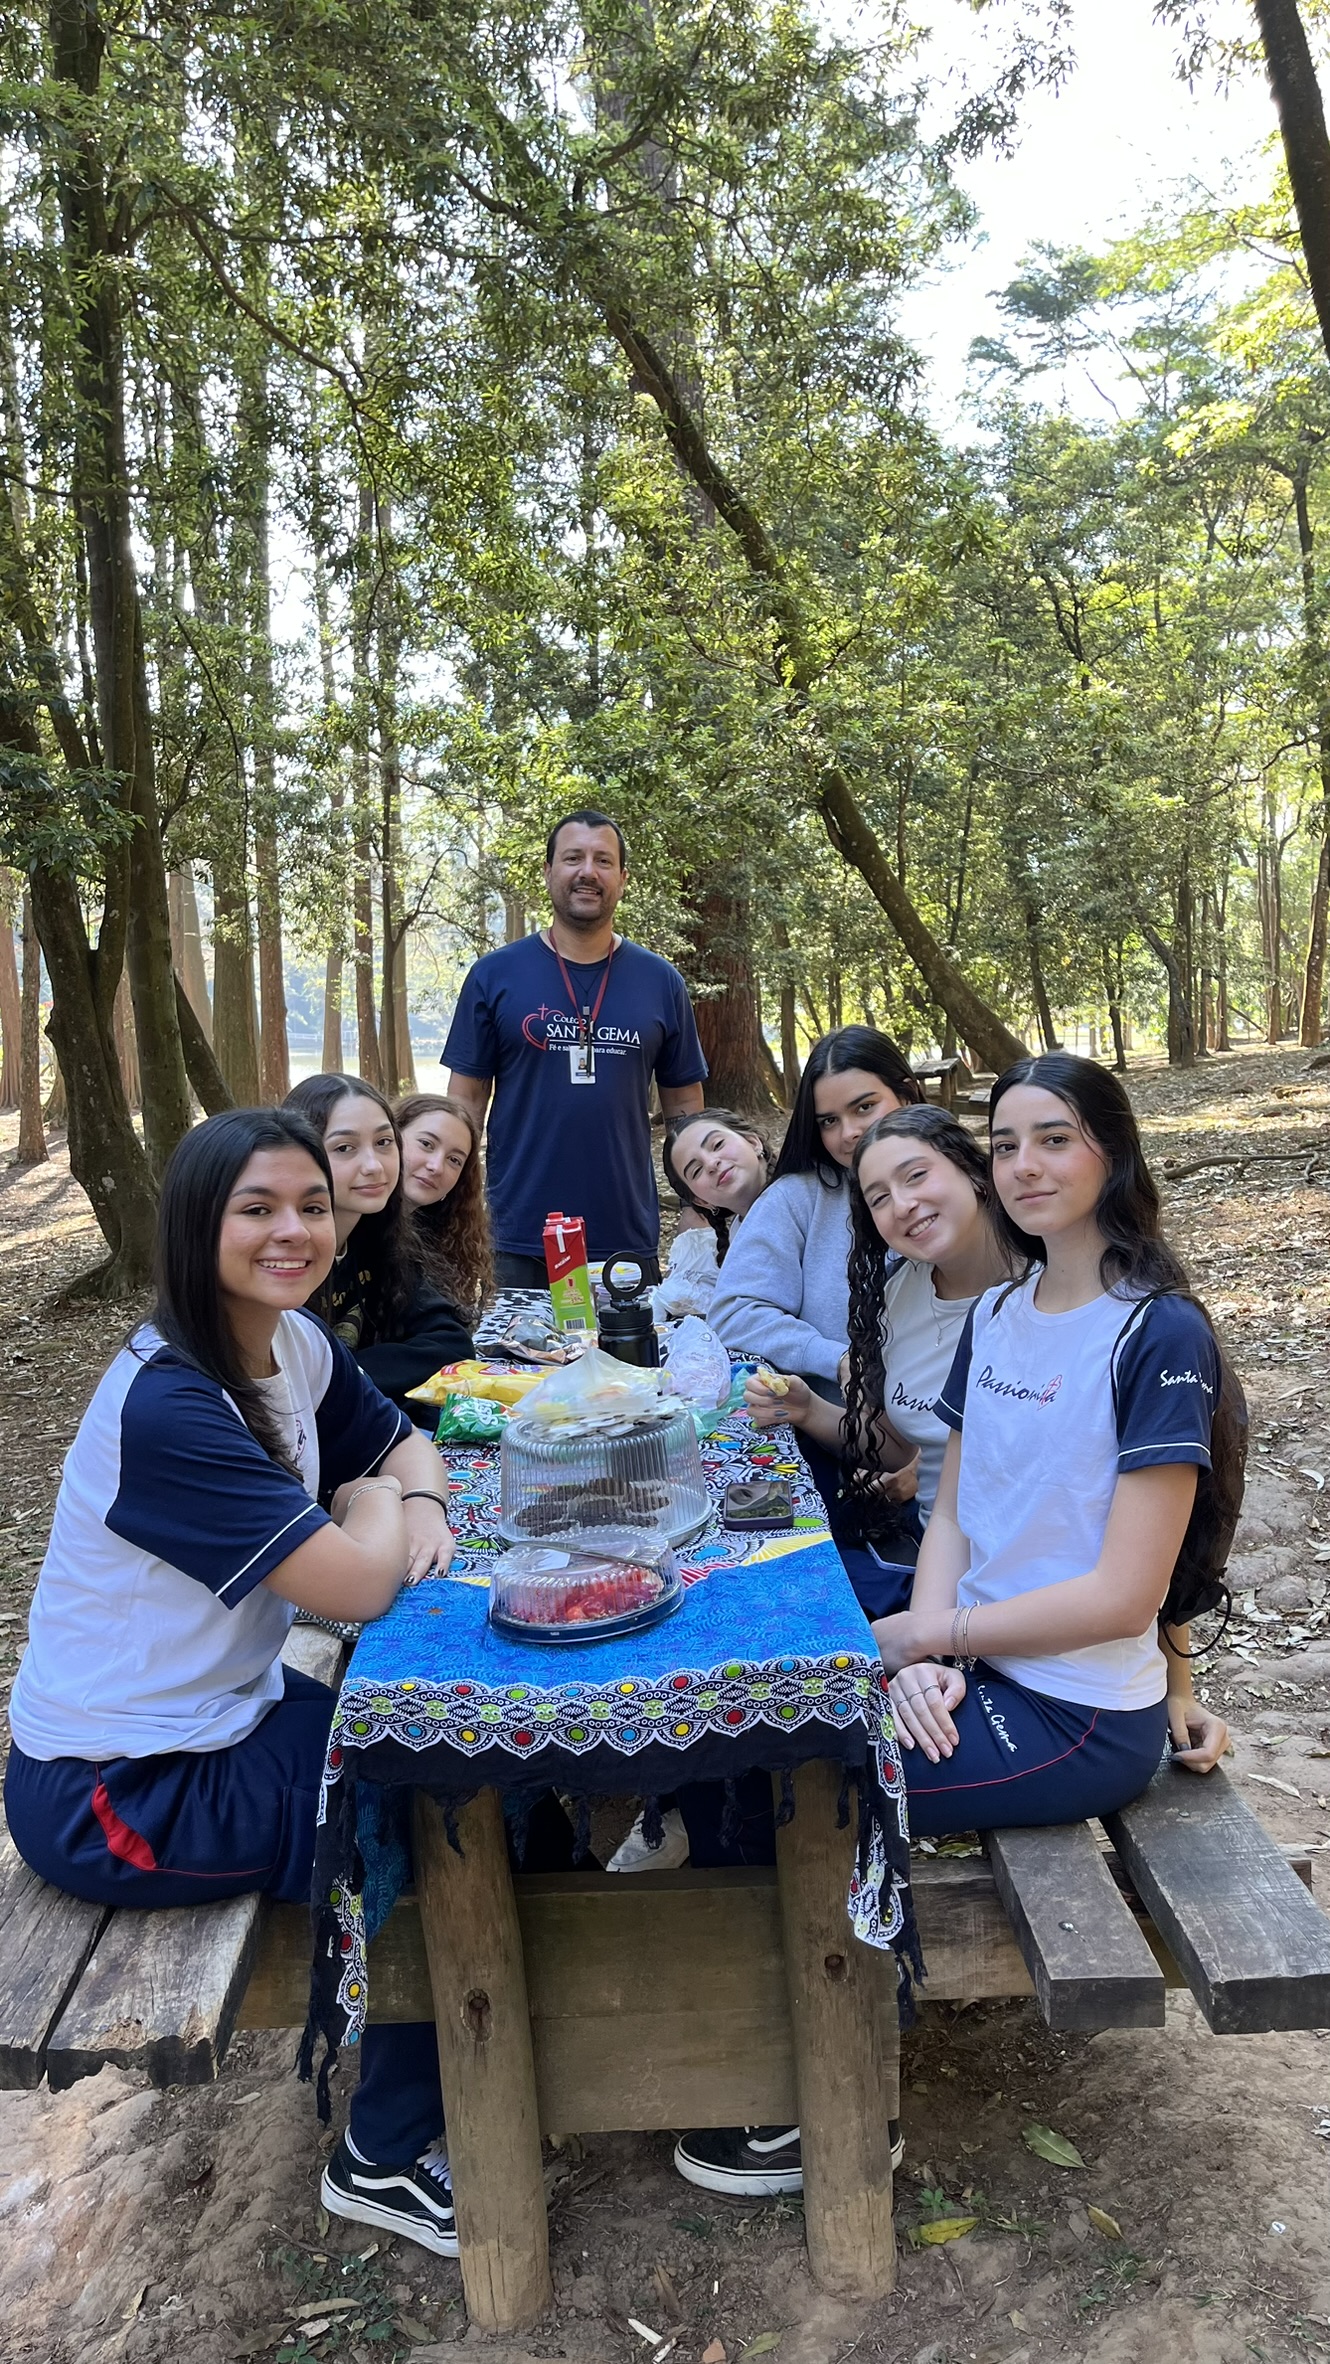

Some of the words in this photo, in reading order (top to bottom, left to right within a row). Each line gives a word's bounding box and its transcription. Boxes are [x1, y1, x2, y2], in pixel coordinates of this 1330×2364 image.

[553, 1014, 587, 1025] COLÉGO
[546, 1023, 595, 1041] SAN
[597, 1026, 641, 1044] GEMA
[1160, 1369, 1198, 1387] Santa
[891, 1382, 934, 1412] Passi
[990, 1714, 1018, 1753] Gema
